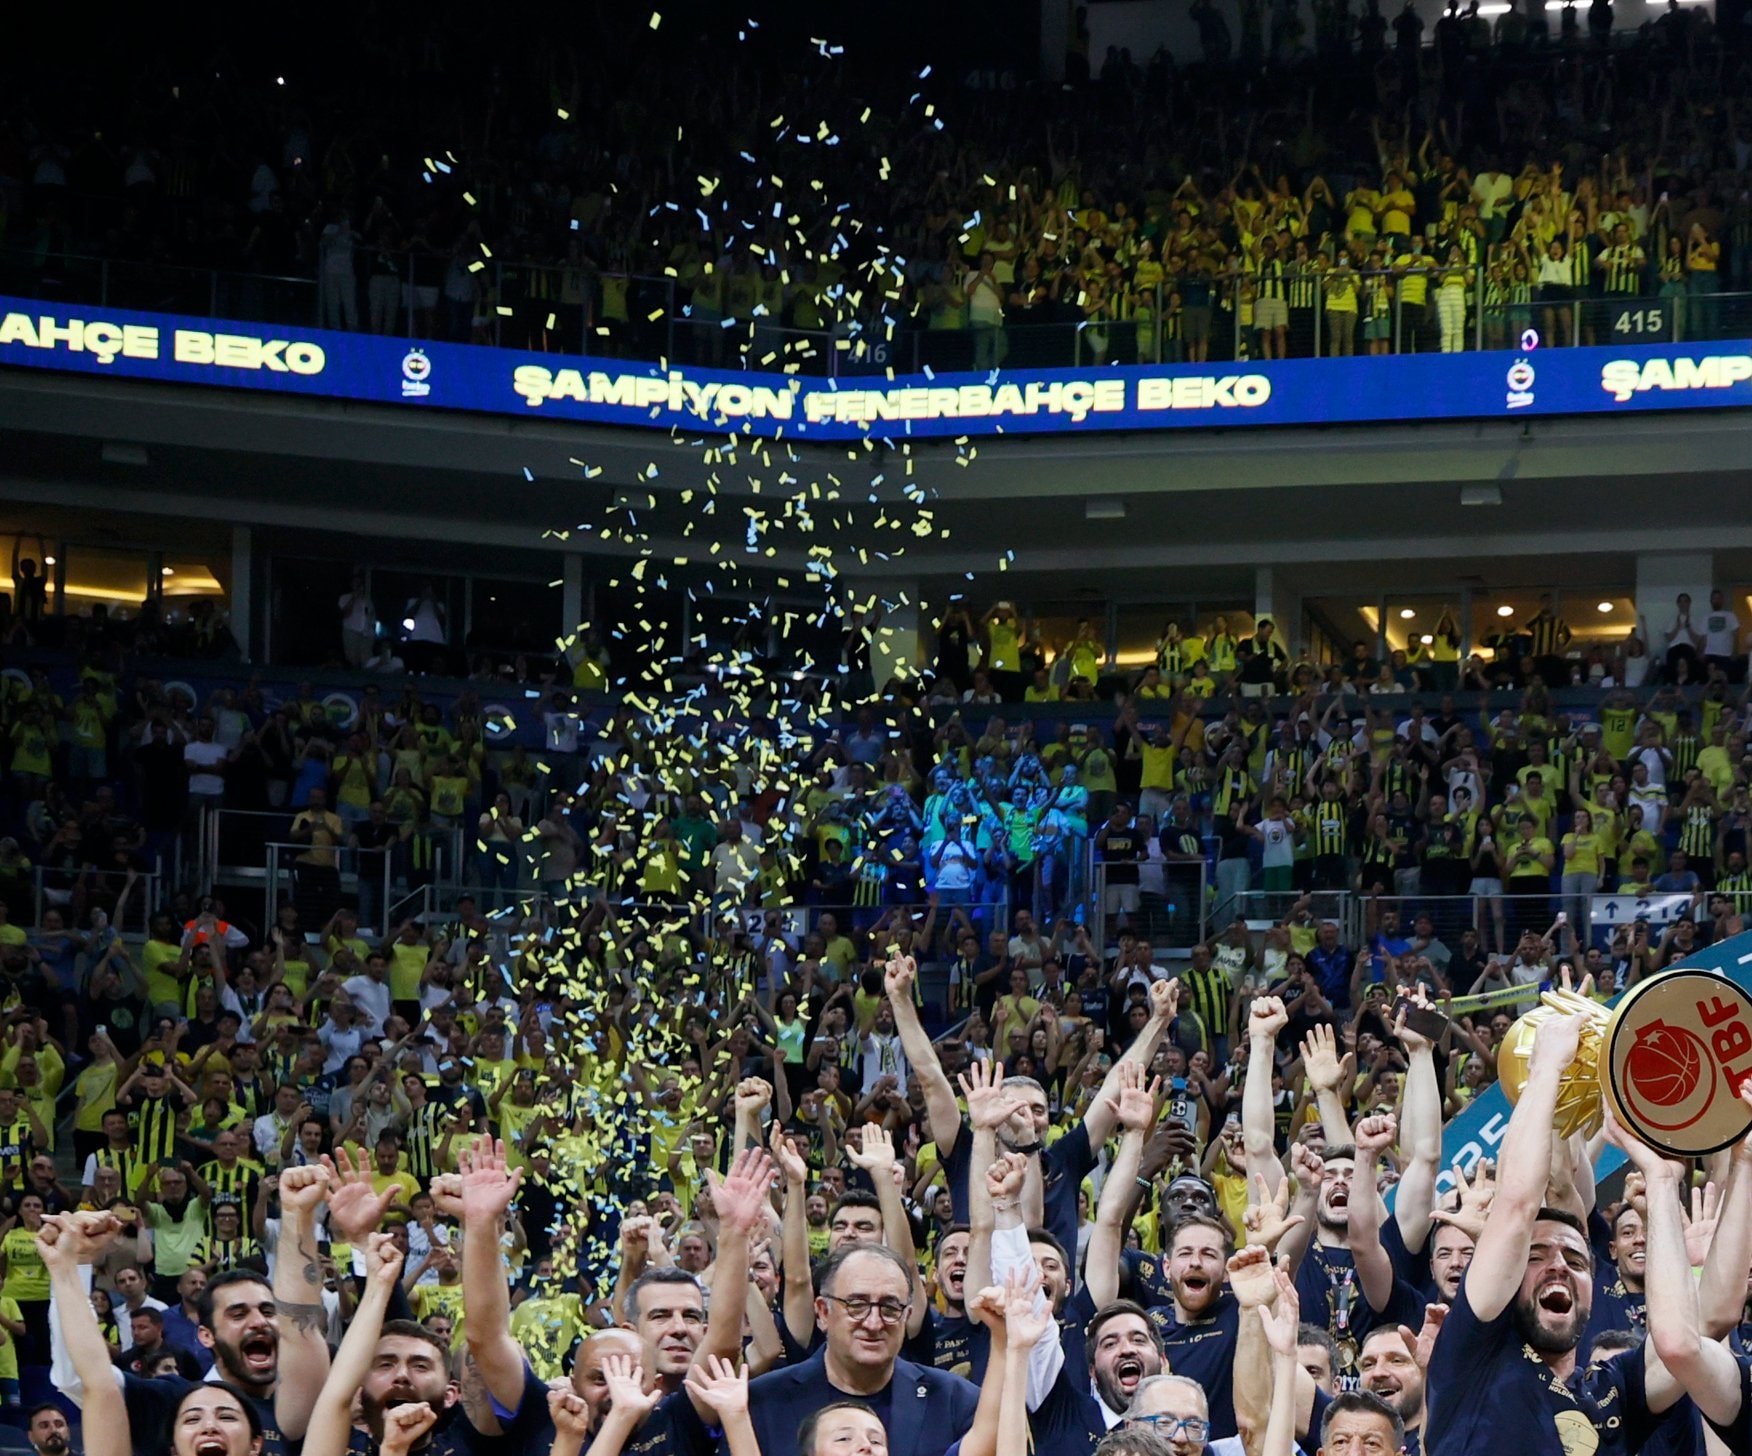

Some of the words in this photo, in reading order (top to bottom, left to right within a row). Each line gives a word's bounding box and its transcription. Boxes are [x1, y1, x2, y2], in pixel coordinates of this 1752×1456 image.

[1614, 308, 1663, 335] 415
[174, 330, 326, 375] BEKO
[847, 340, 888, 365] 416
[514, 364, 793, 421] ŞAMPİYON
[804, 378, 1125, 422] FENERBAHÇE
[1137, 374, 1271, 410] BEKO
